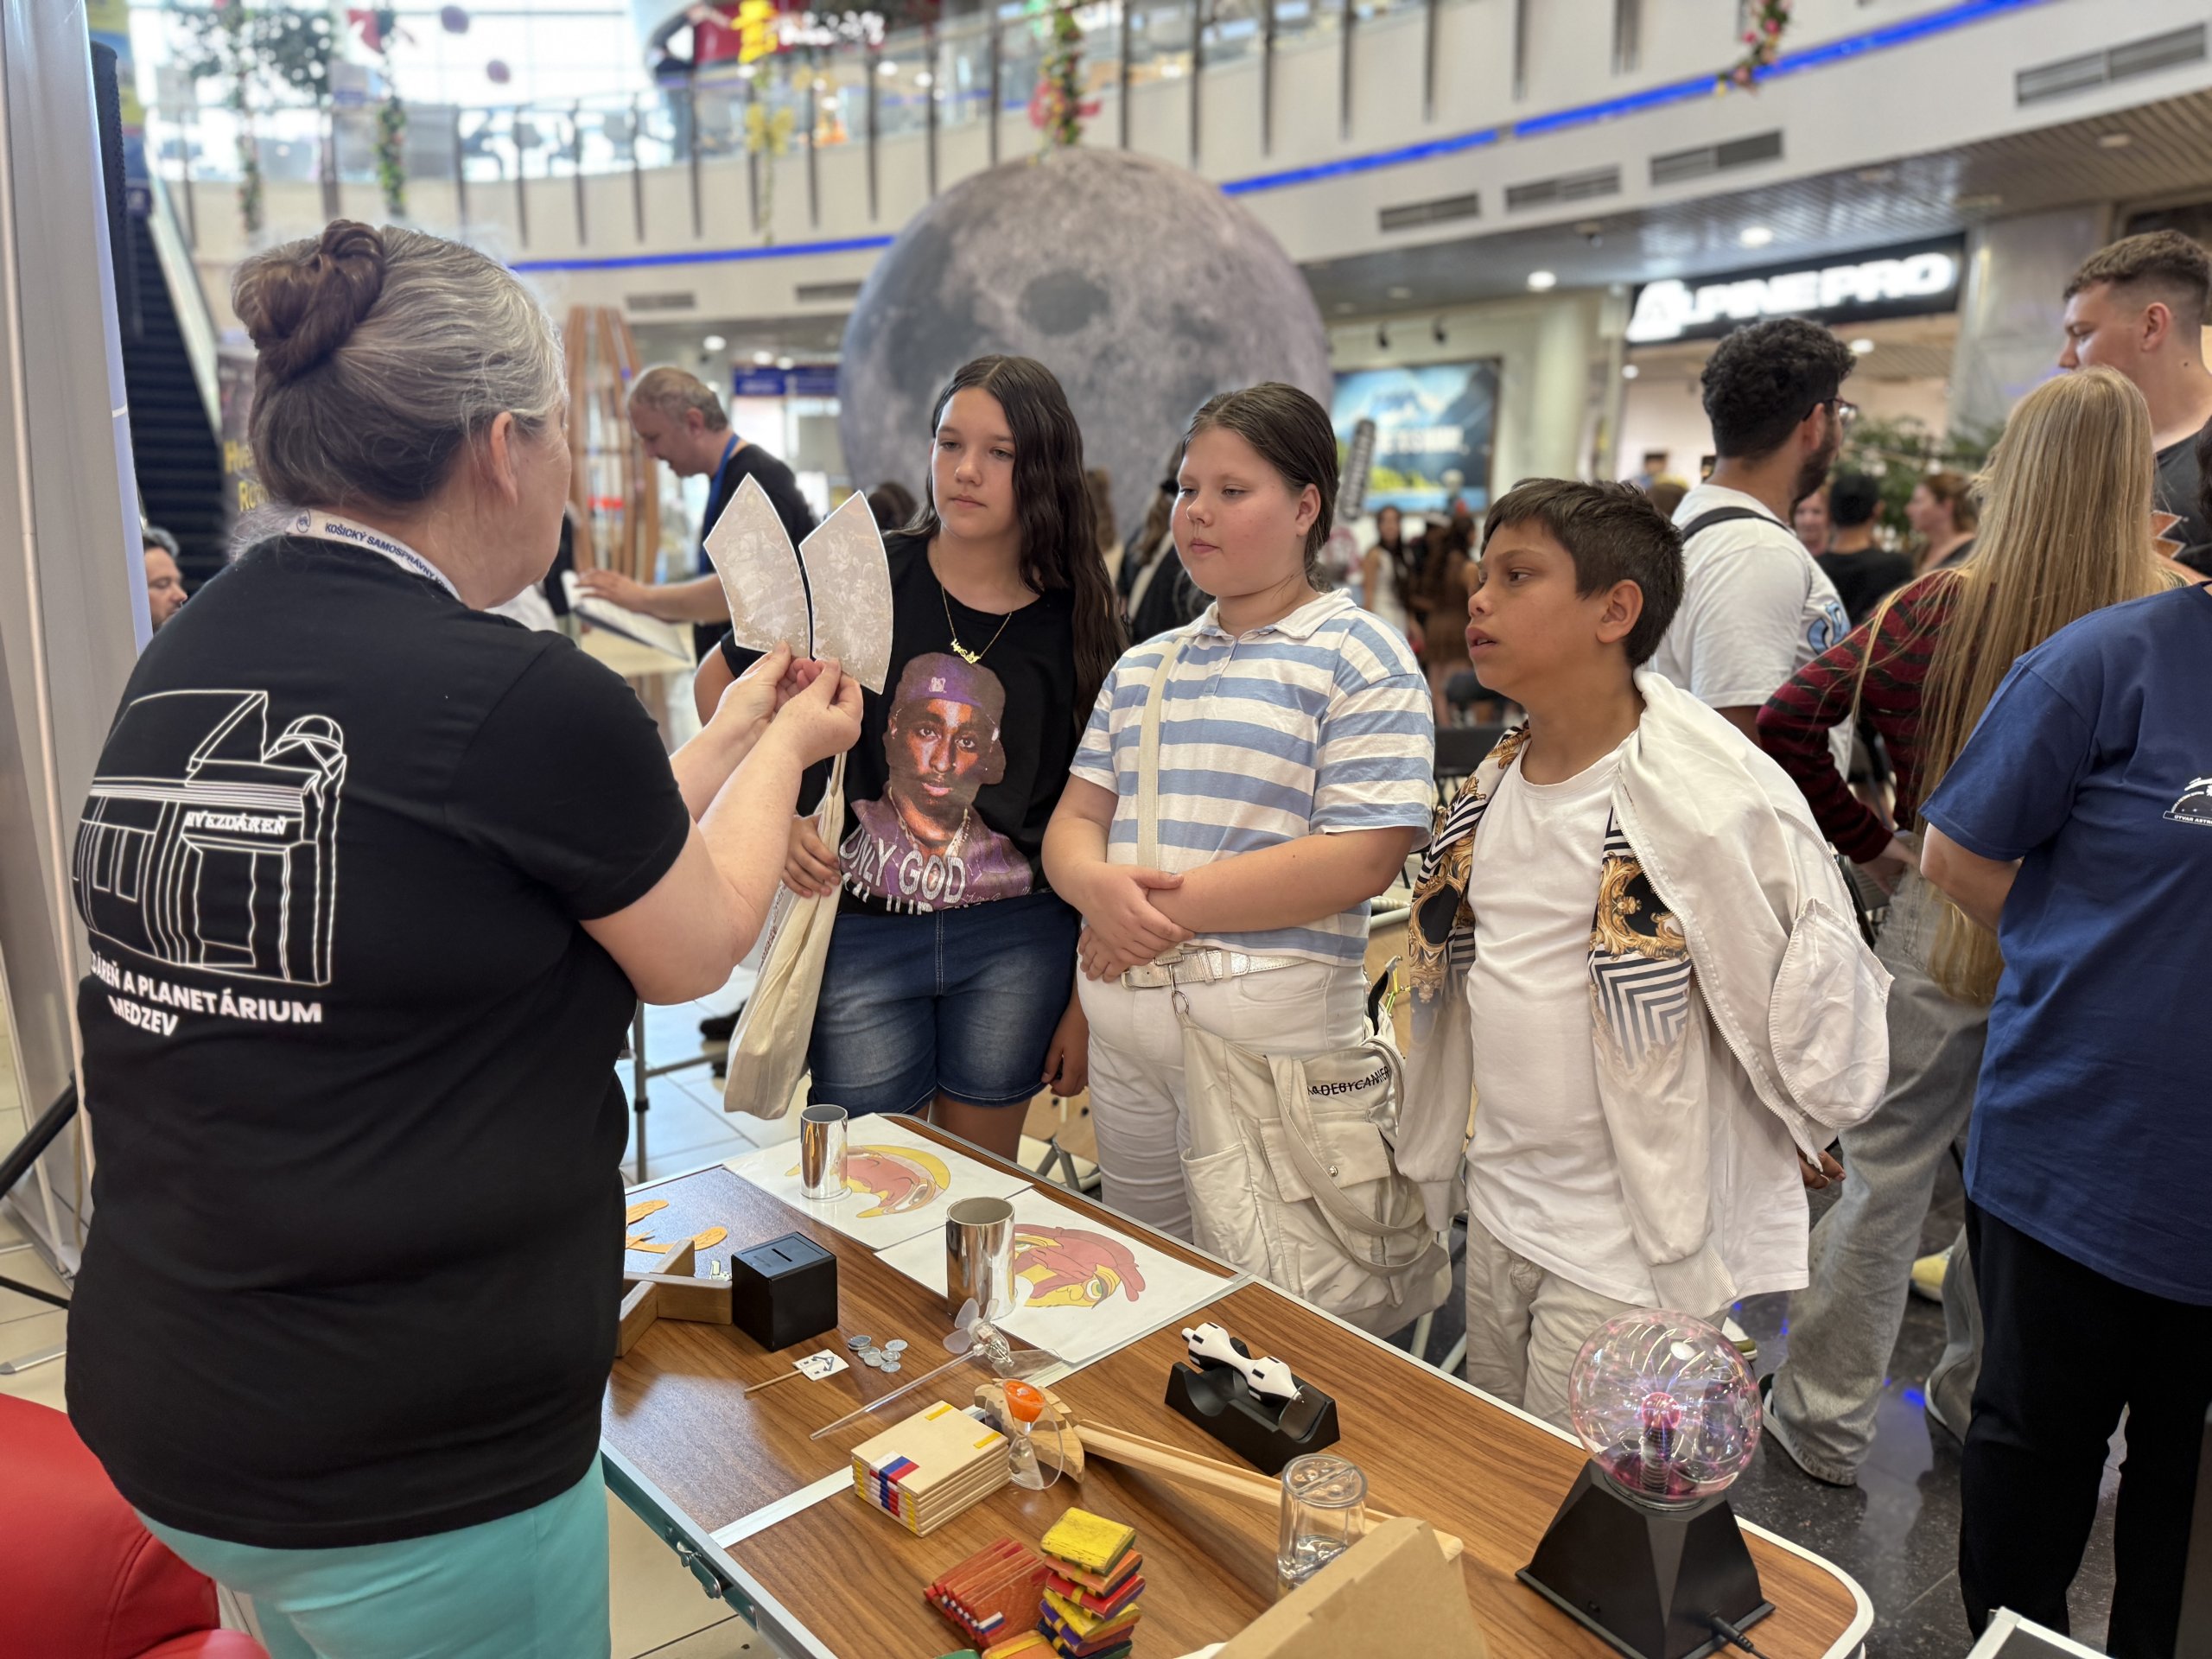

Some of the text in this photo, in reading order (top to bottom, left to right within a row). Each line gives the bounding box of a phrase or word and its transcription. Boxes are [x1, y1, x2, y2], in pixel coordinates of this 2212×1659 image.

[1821, 252, 1955, 308] PRO
[325, 522, 435, 579] KOŠICKÝ SAMOSPRÁVNY
[840, 823, 898, 887] ONLY
[899, 849, 966, 904] GOD
[107, 995, 179, 1037] MEDZEV
[123, 969, 137, 995] A
[137, 974, 322, 1024] PLANETÁRIUM
